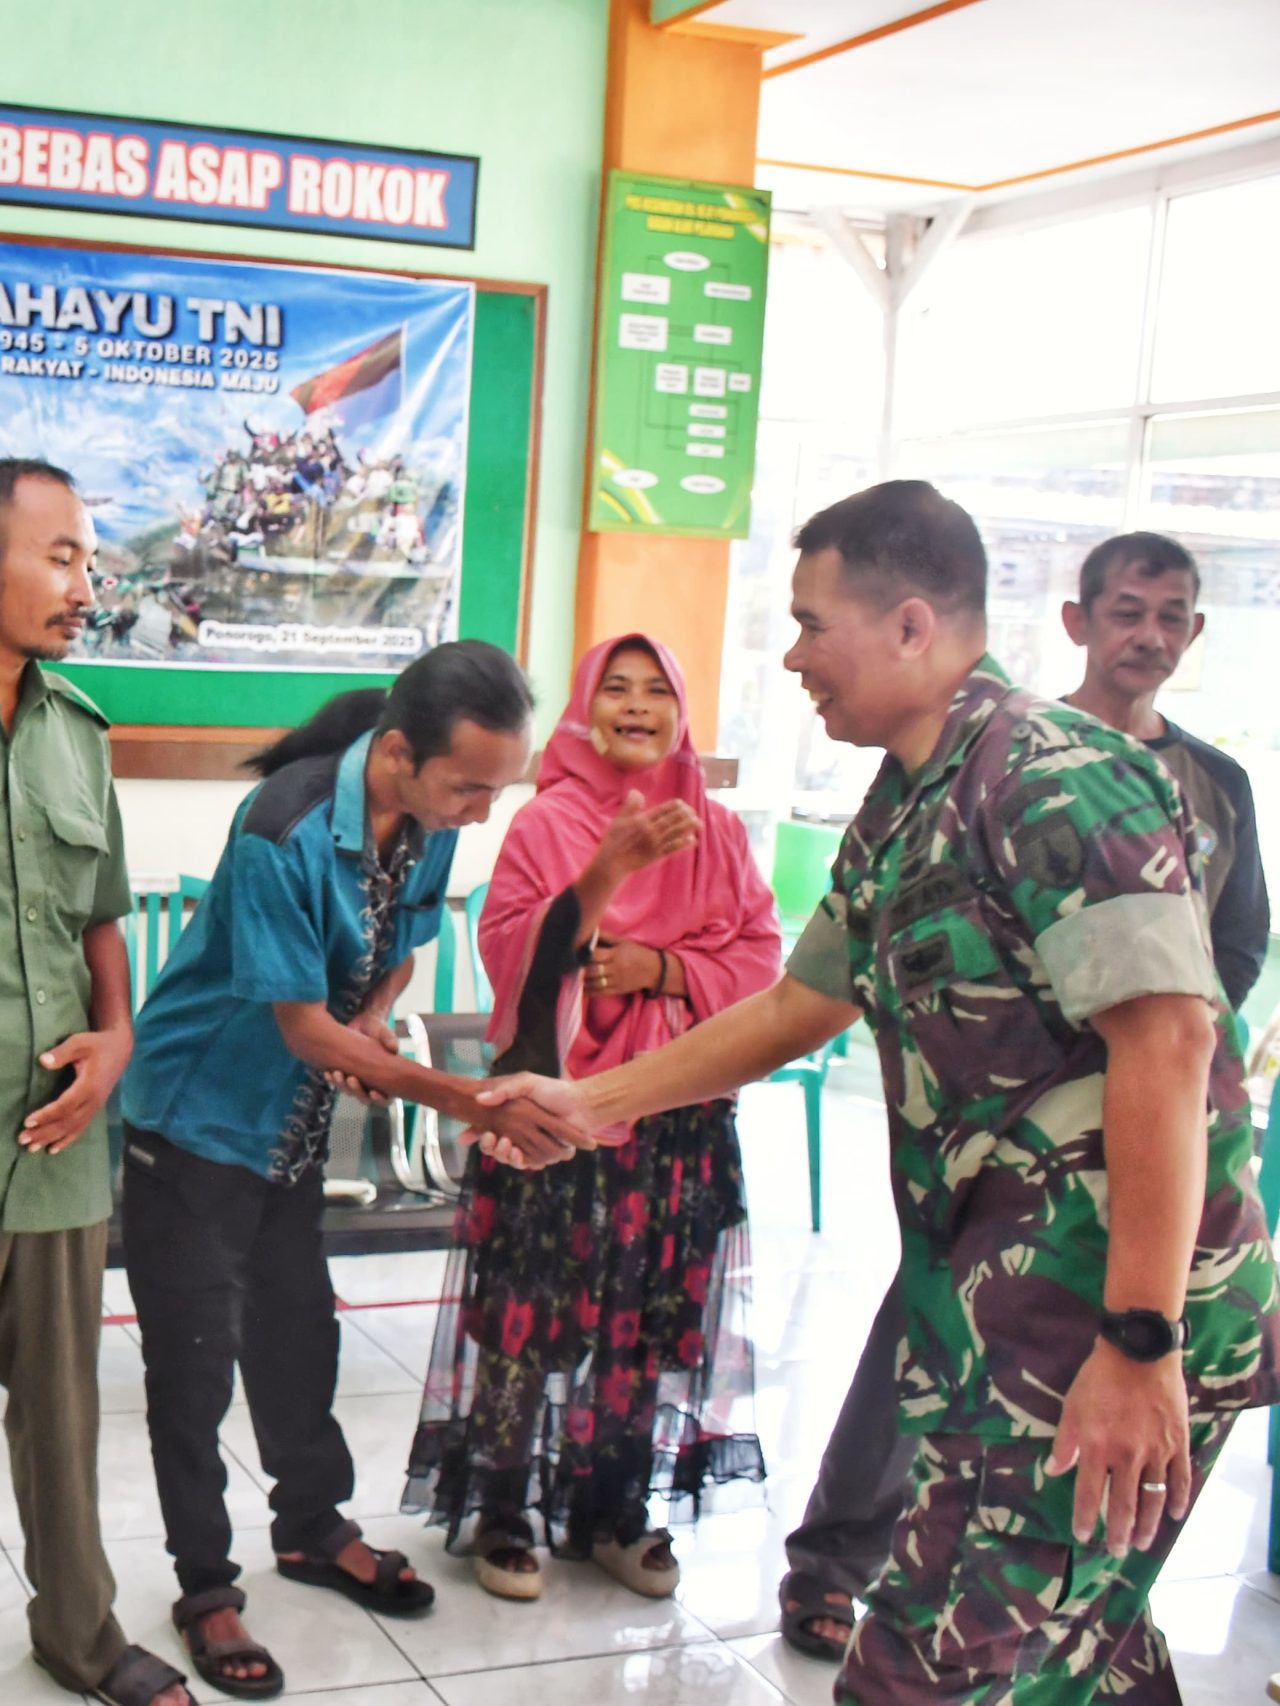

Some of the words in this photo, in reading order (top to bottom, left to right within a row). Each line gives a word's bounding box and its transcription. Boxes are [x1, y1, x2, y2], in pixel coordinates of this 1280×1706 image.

[153, 140, 282, 210] ASAP
[287, 154, 450, 229] ROKOK
[187, 296, 282, 347] TNI
[74, 335, 88, 357] 5
[96, 337, 212, 366] OKTOBER
[221, 347, 280, 371] 2025
[1, 354, 84, 378] RAKYAT
[104, 363, 215, 389] INDONESIA
[221, 373, 280, 395] MAJU
[206, 628, 278, 645] Ponorogo,
[282, 630, 297, 642] 21
[303, 631, 378, 648] September
[382, 635, 416, 648] 2025
